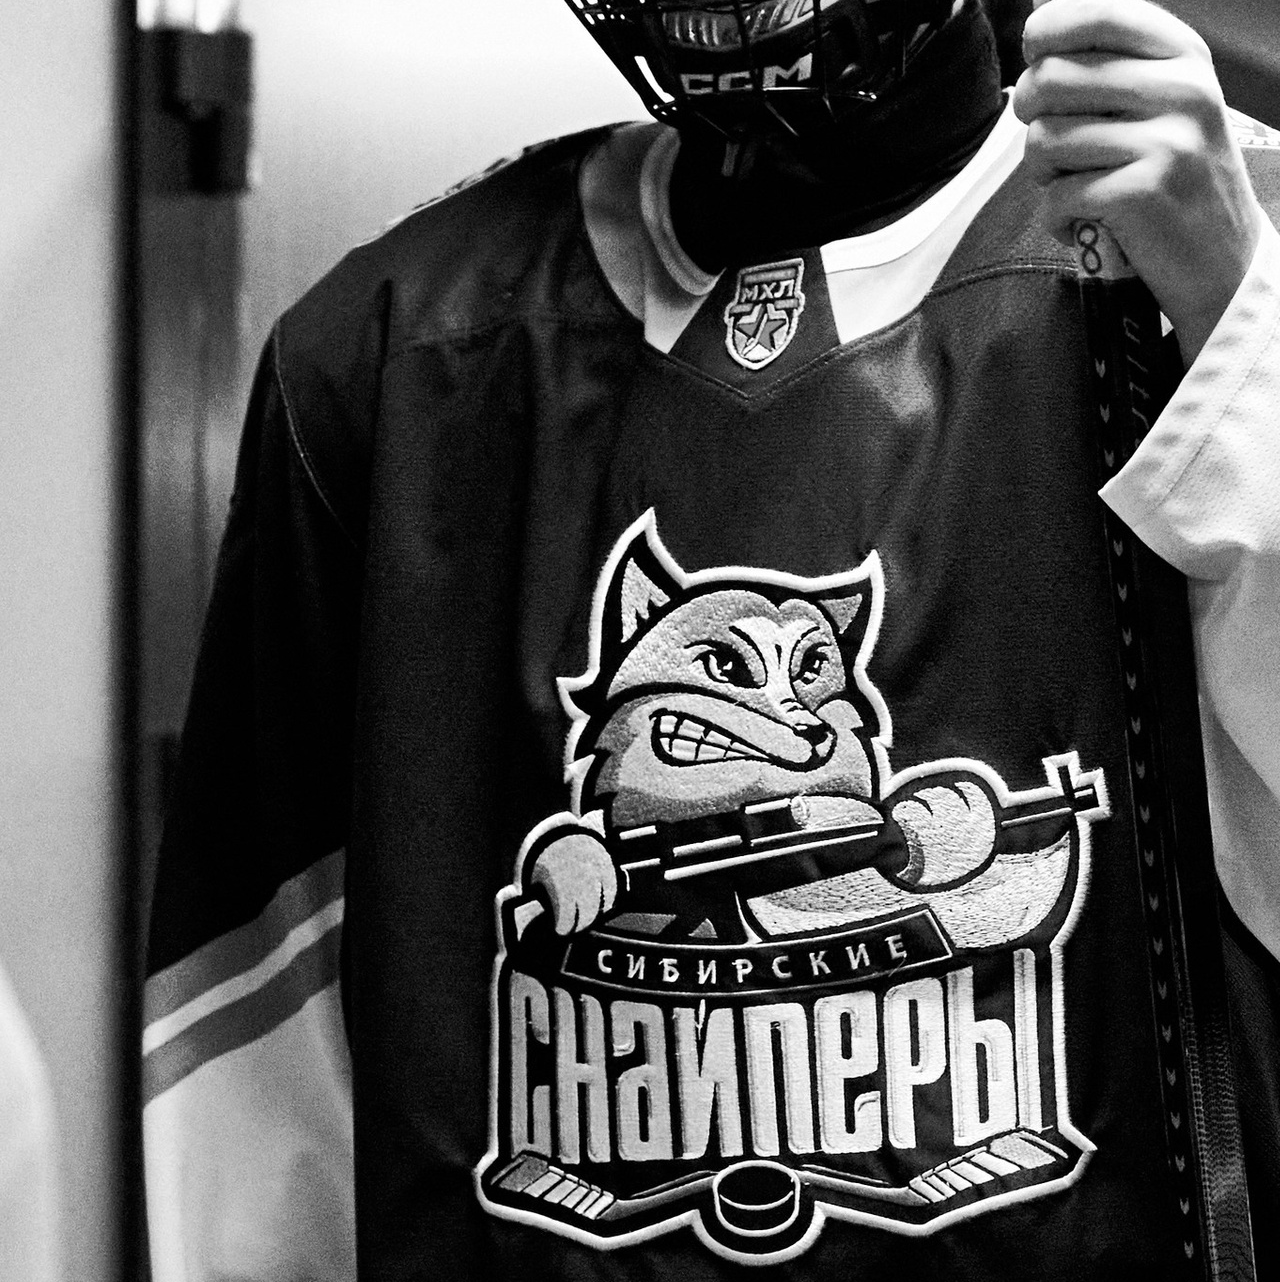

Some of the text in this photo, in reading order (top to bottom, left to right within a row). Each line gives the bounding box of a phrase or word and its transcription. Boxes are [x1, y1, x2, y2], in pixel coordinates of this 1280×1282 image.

[679, 52, 814, 95] CCM
[1077, 223, 1102, 275] 8
[740, 279, 795, 303] МХЛ
[598, 933, 908, 985] СИБИРСКИЕ
